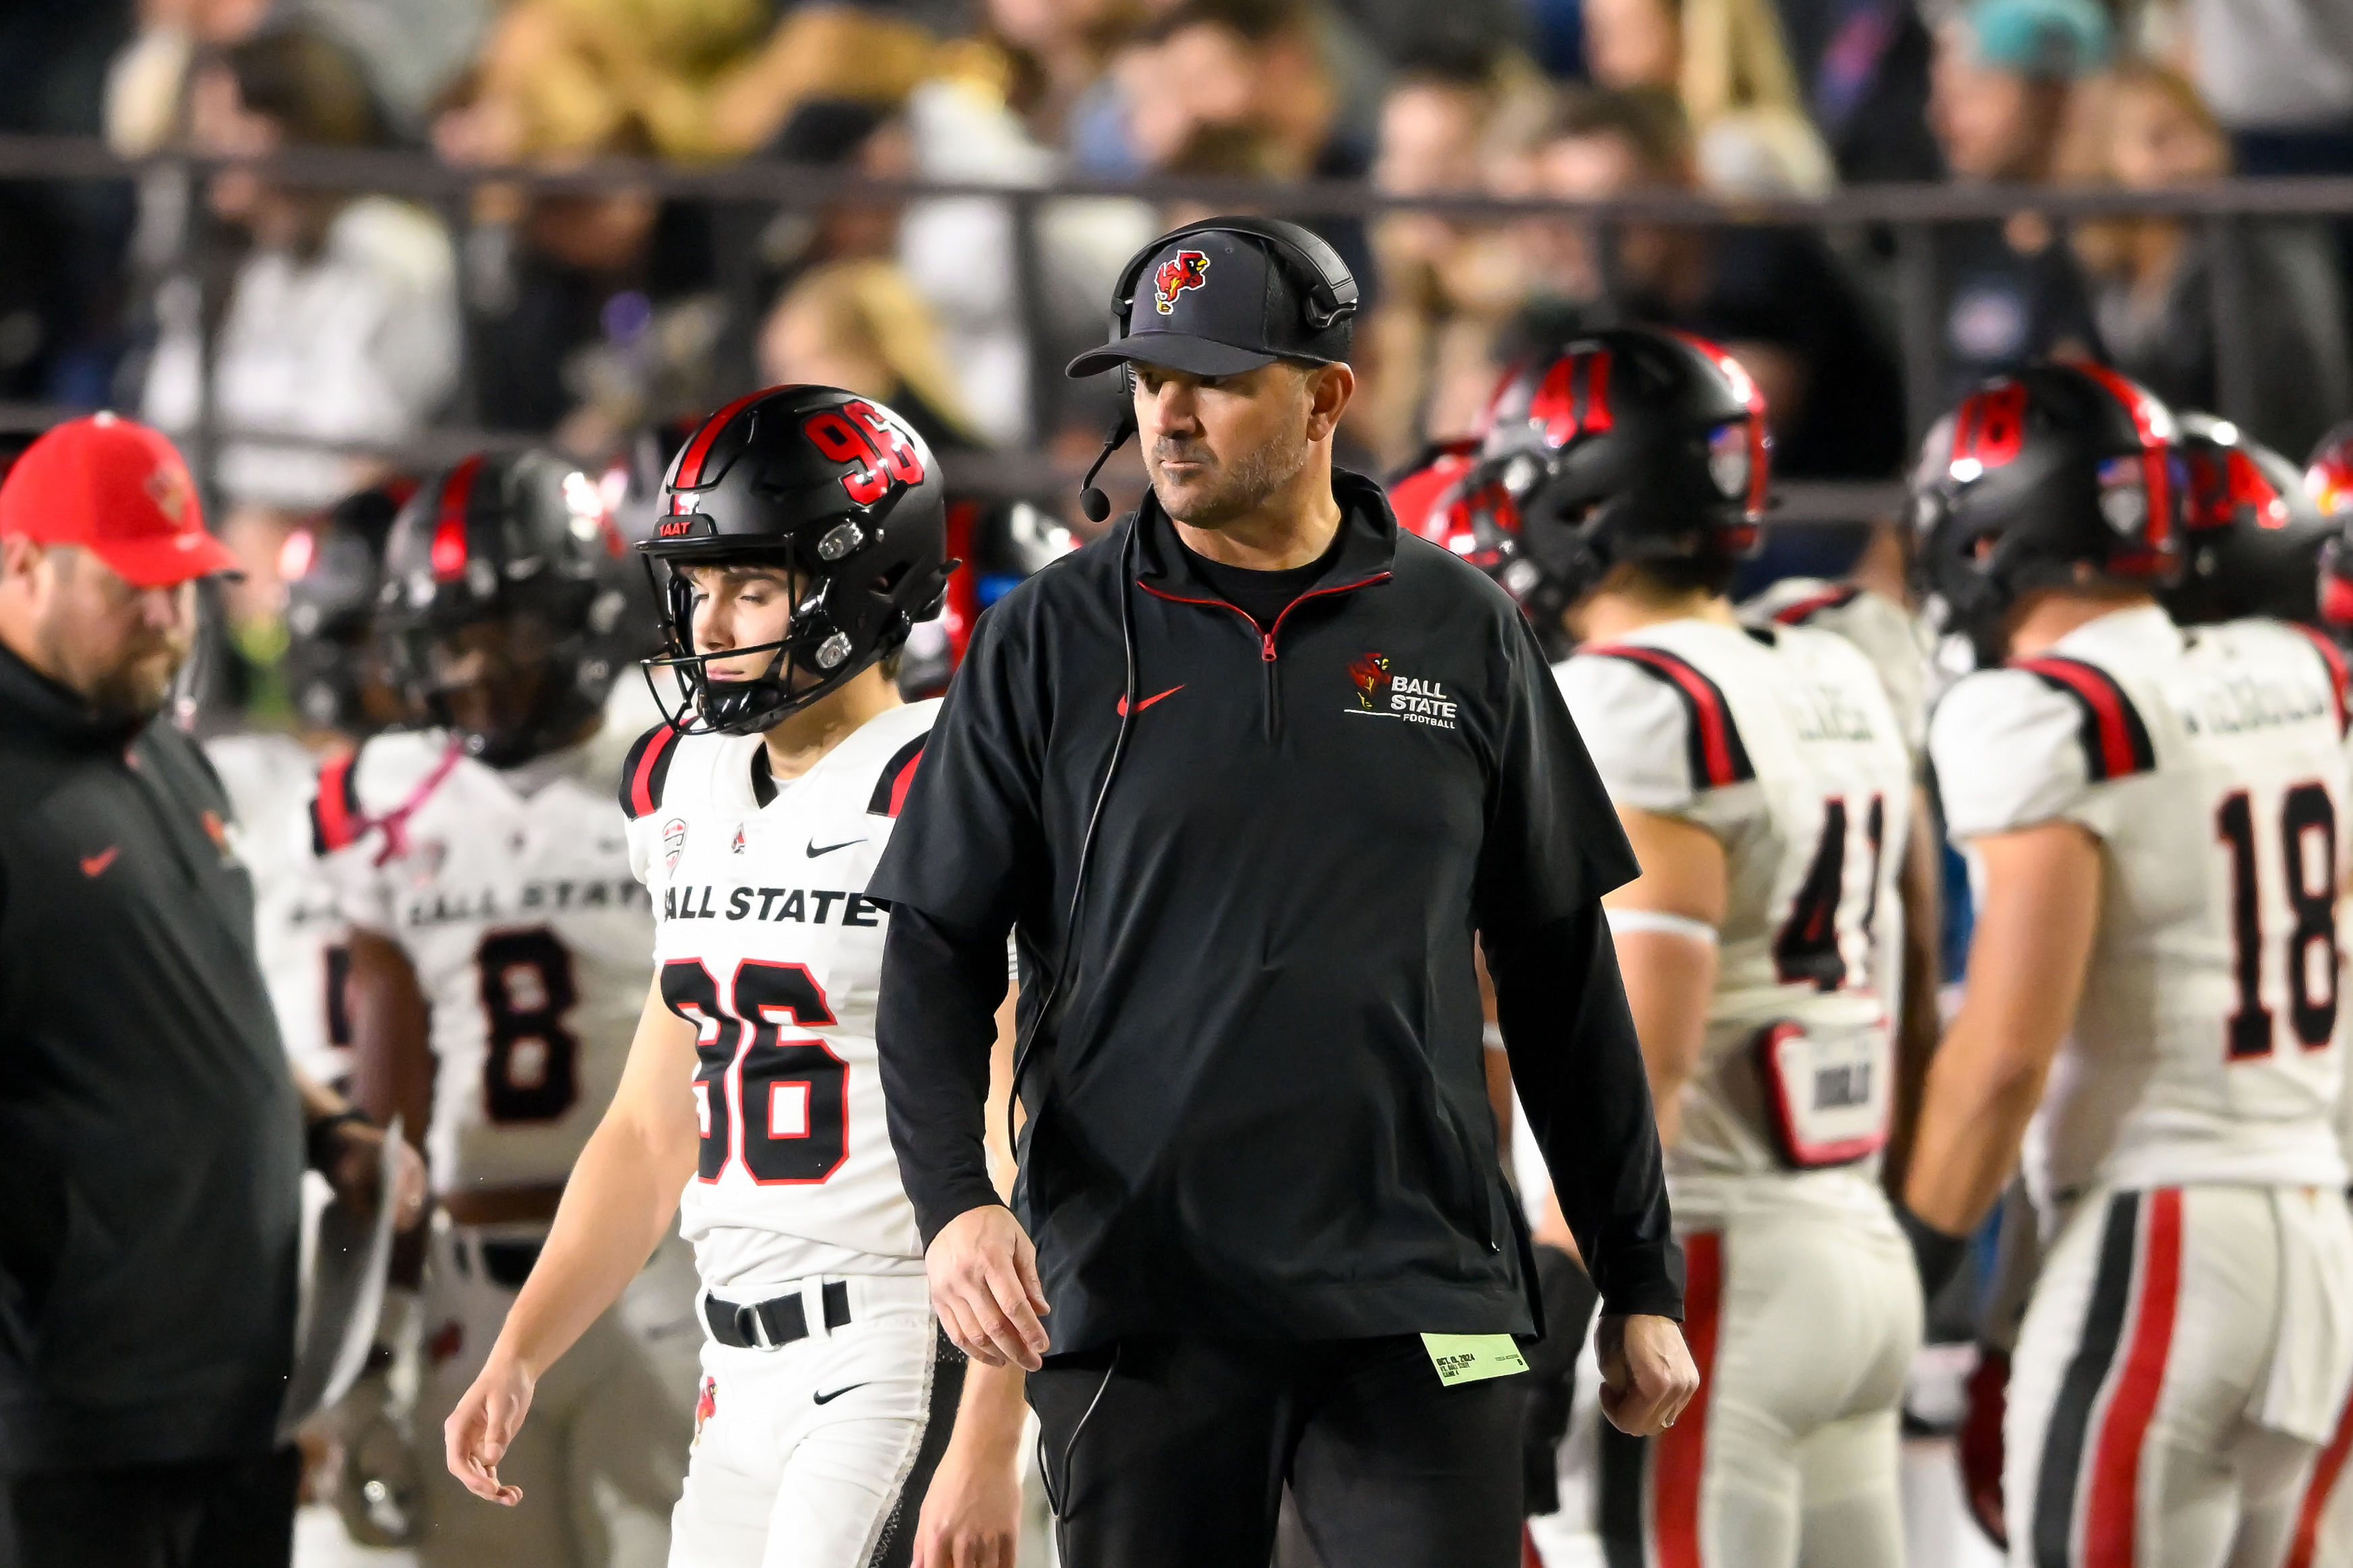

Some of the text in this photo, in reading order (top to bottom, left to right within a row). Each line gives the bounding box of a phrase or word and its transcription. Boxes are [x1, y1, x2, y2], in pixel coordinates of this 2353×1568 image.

[803, 398, 925, 507] 96
[1391, 675, 1447, 699] BALL
[1391, 694, 1457, 718] STATE
[1403, 714, 1456, 729] FOOTBALL
[665, 885, 880, 927] ALL STATE
[1773, 790, 1885, 997] 41
[2214, 777, 2336, 1060] 18
[477, 922, 578, 1129] 8
[660, 957, 851, 1186] 96
[1459, 1353, 1475, 1362] 2024
